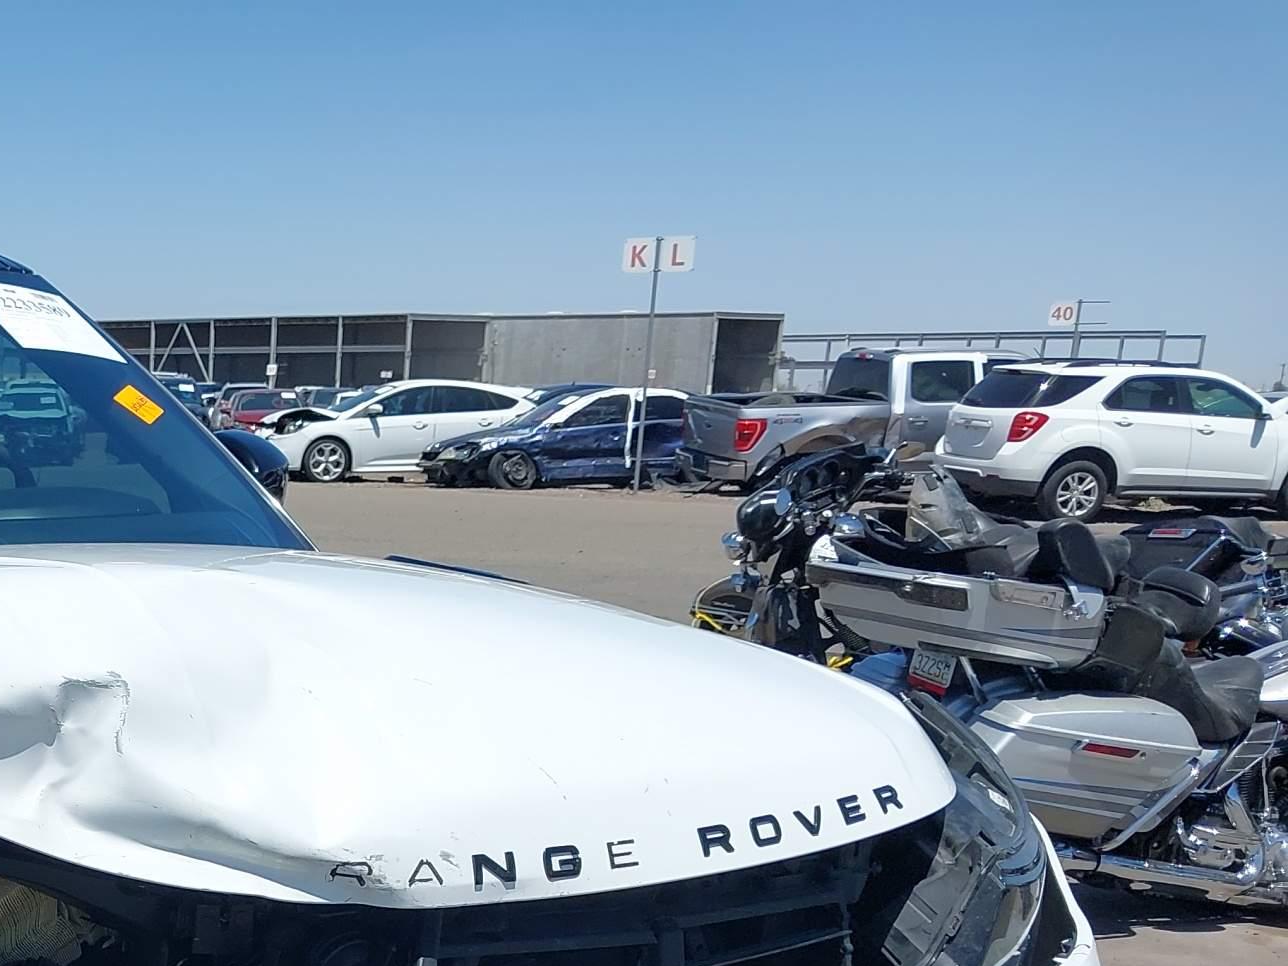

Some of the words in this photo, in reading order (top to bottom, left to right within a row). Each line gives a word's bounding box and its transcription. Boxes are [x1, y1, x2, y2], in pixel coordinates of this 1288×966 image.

[630, 244, 648, 268] K
[671, 243, 686, 266] L
[1050, 305, 1074, 321] 40
[326, 838, 640, 892] RANGE
[696, 784, 904, 858] ROVER
